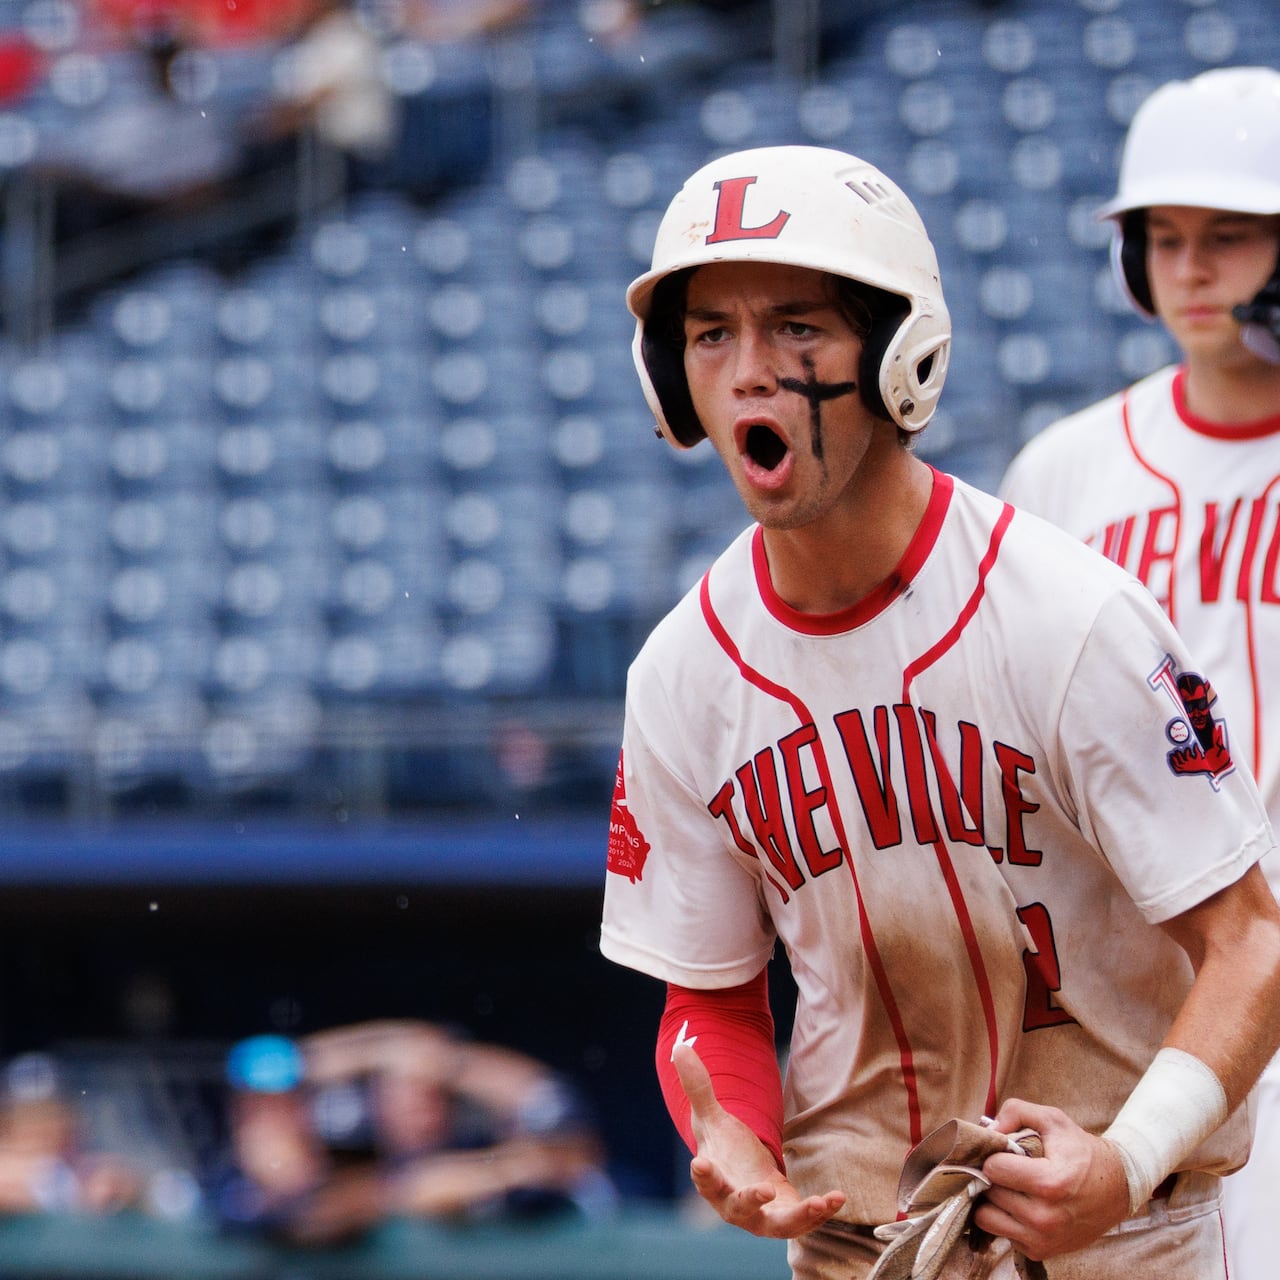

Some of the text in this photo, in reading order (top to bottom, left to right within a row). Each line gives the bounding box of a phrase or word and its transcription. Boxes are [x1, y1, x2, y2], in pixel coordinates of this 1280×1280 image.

[705, 176, 791, 245] L
[708, 722, 843, 905] THE
[1016, 901, 1082, 1033] 2
